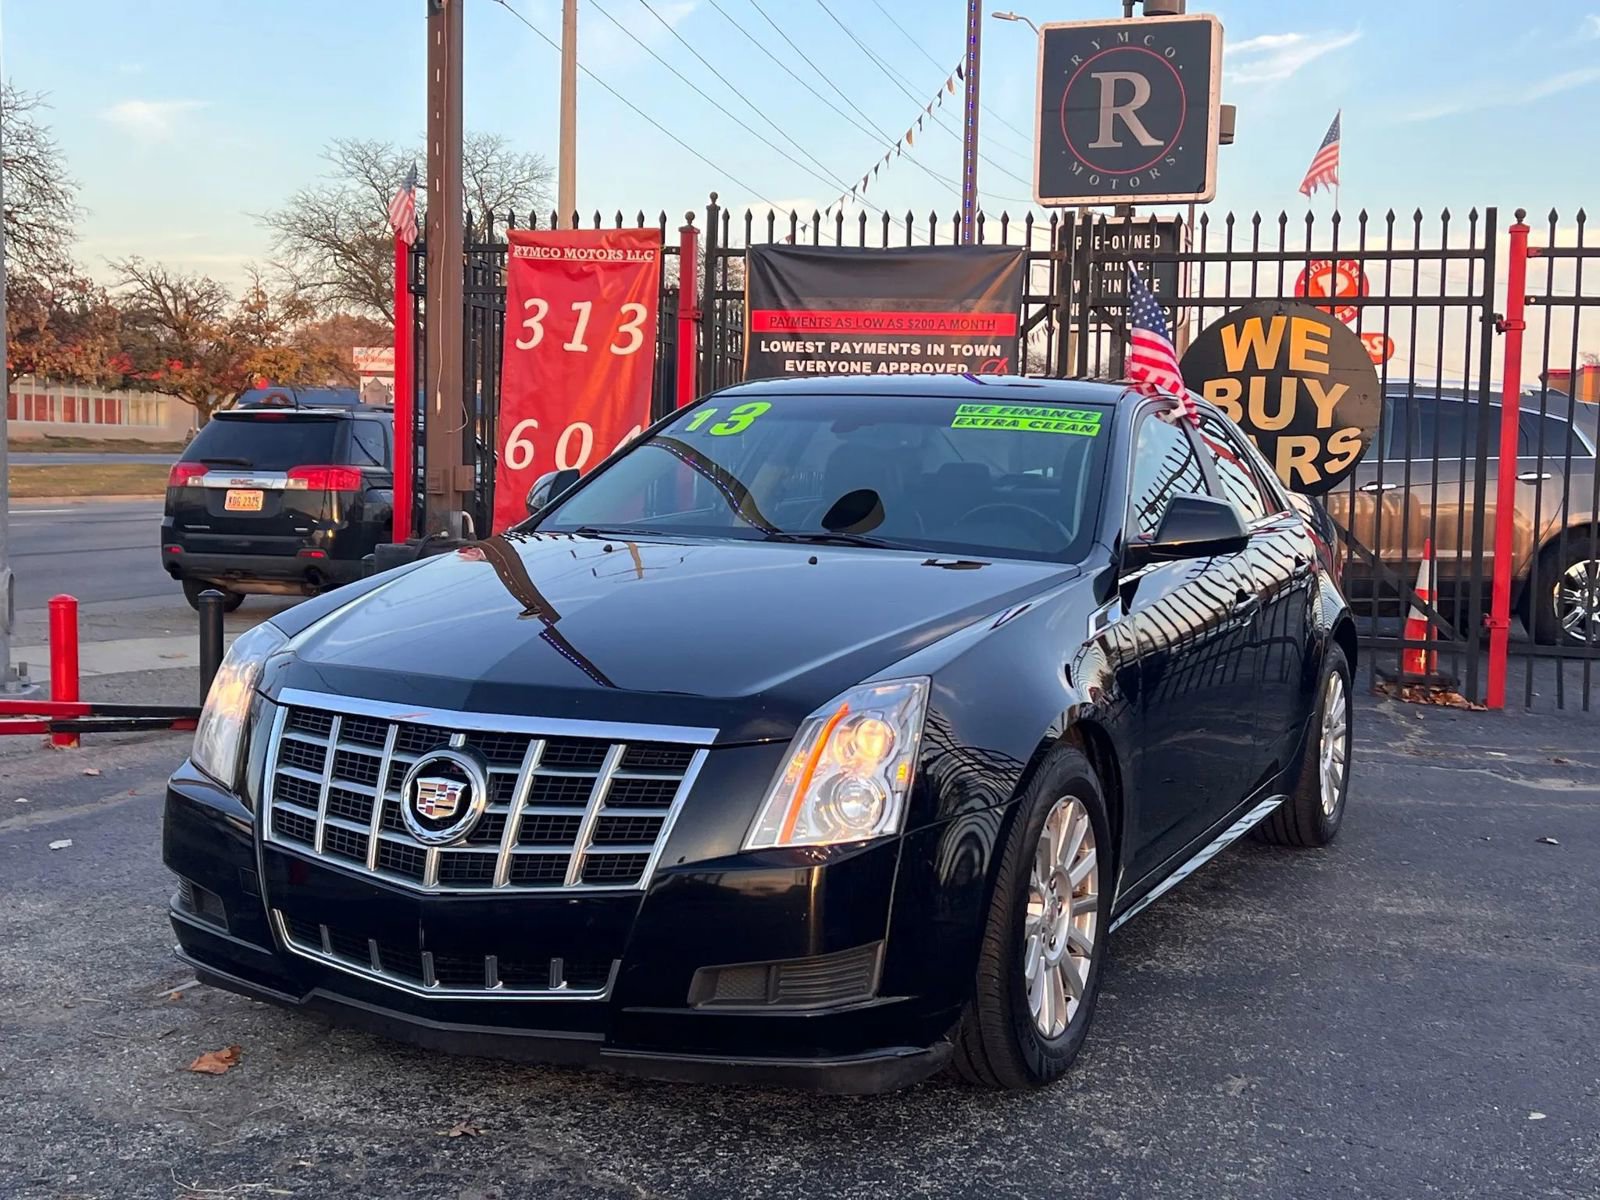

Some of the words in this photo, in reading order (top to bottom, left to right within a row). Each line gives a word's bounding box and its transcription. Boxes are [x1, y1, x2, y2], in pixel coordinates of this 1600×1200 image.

[1070, 31, 1176, 66] RYMCO
[1088, 71, 1164, 148] R
[1069, 155, 1176, 189] MOTORS
[513, 245, 561, 258] RYMCO
[563, 248, 623, 260] MOTORS
[626, 249, 654, 261] LLC
[769, 315, 832, 329] PAYMENTS
[835, 317, 852, 329] AS
[855, 317, 883, 330] LOW
[886, 318, 904, 330] AS
[908, 318, 934, 330] $200
[937, 319, 947, 330] A
[949, 319, 996, 331] MONTH
[760, 340, 826, 354] LOWEST
[830, 341, 921, 356] PAYMENTS
[926, 343, 945, 356] IN
[950, 344, 1001, 357] TOWN
[1220, 315, 1332, 375] WE
[784, 359, 872, 373] EVERYONE
[877, 362, 969, 374] APPROVED
[960, 404, 994, 414] WE
[997, 406, 1099, 421] FINANCE
[1202, 375, 1350, 431] BUY
[685, 401, 773, 436] 13
[954, 417, 1021, 428] EXTRA
[1027, 419, 1096, 433] CLEAN
